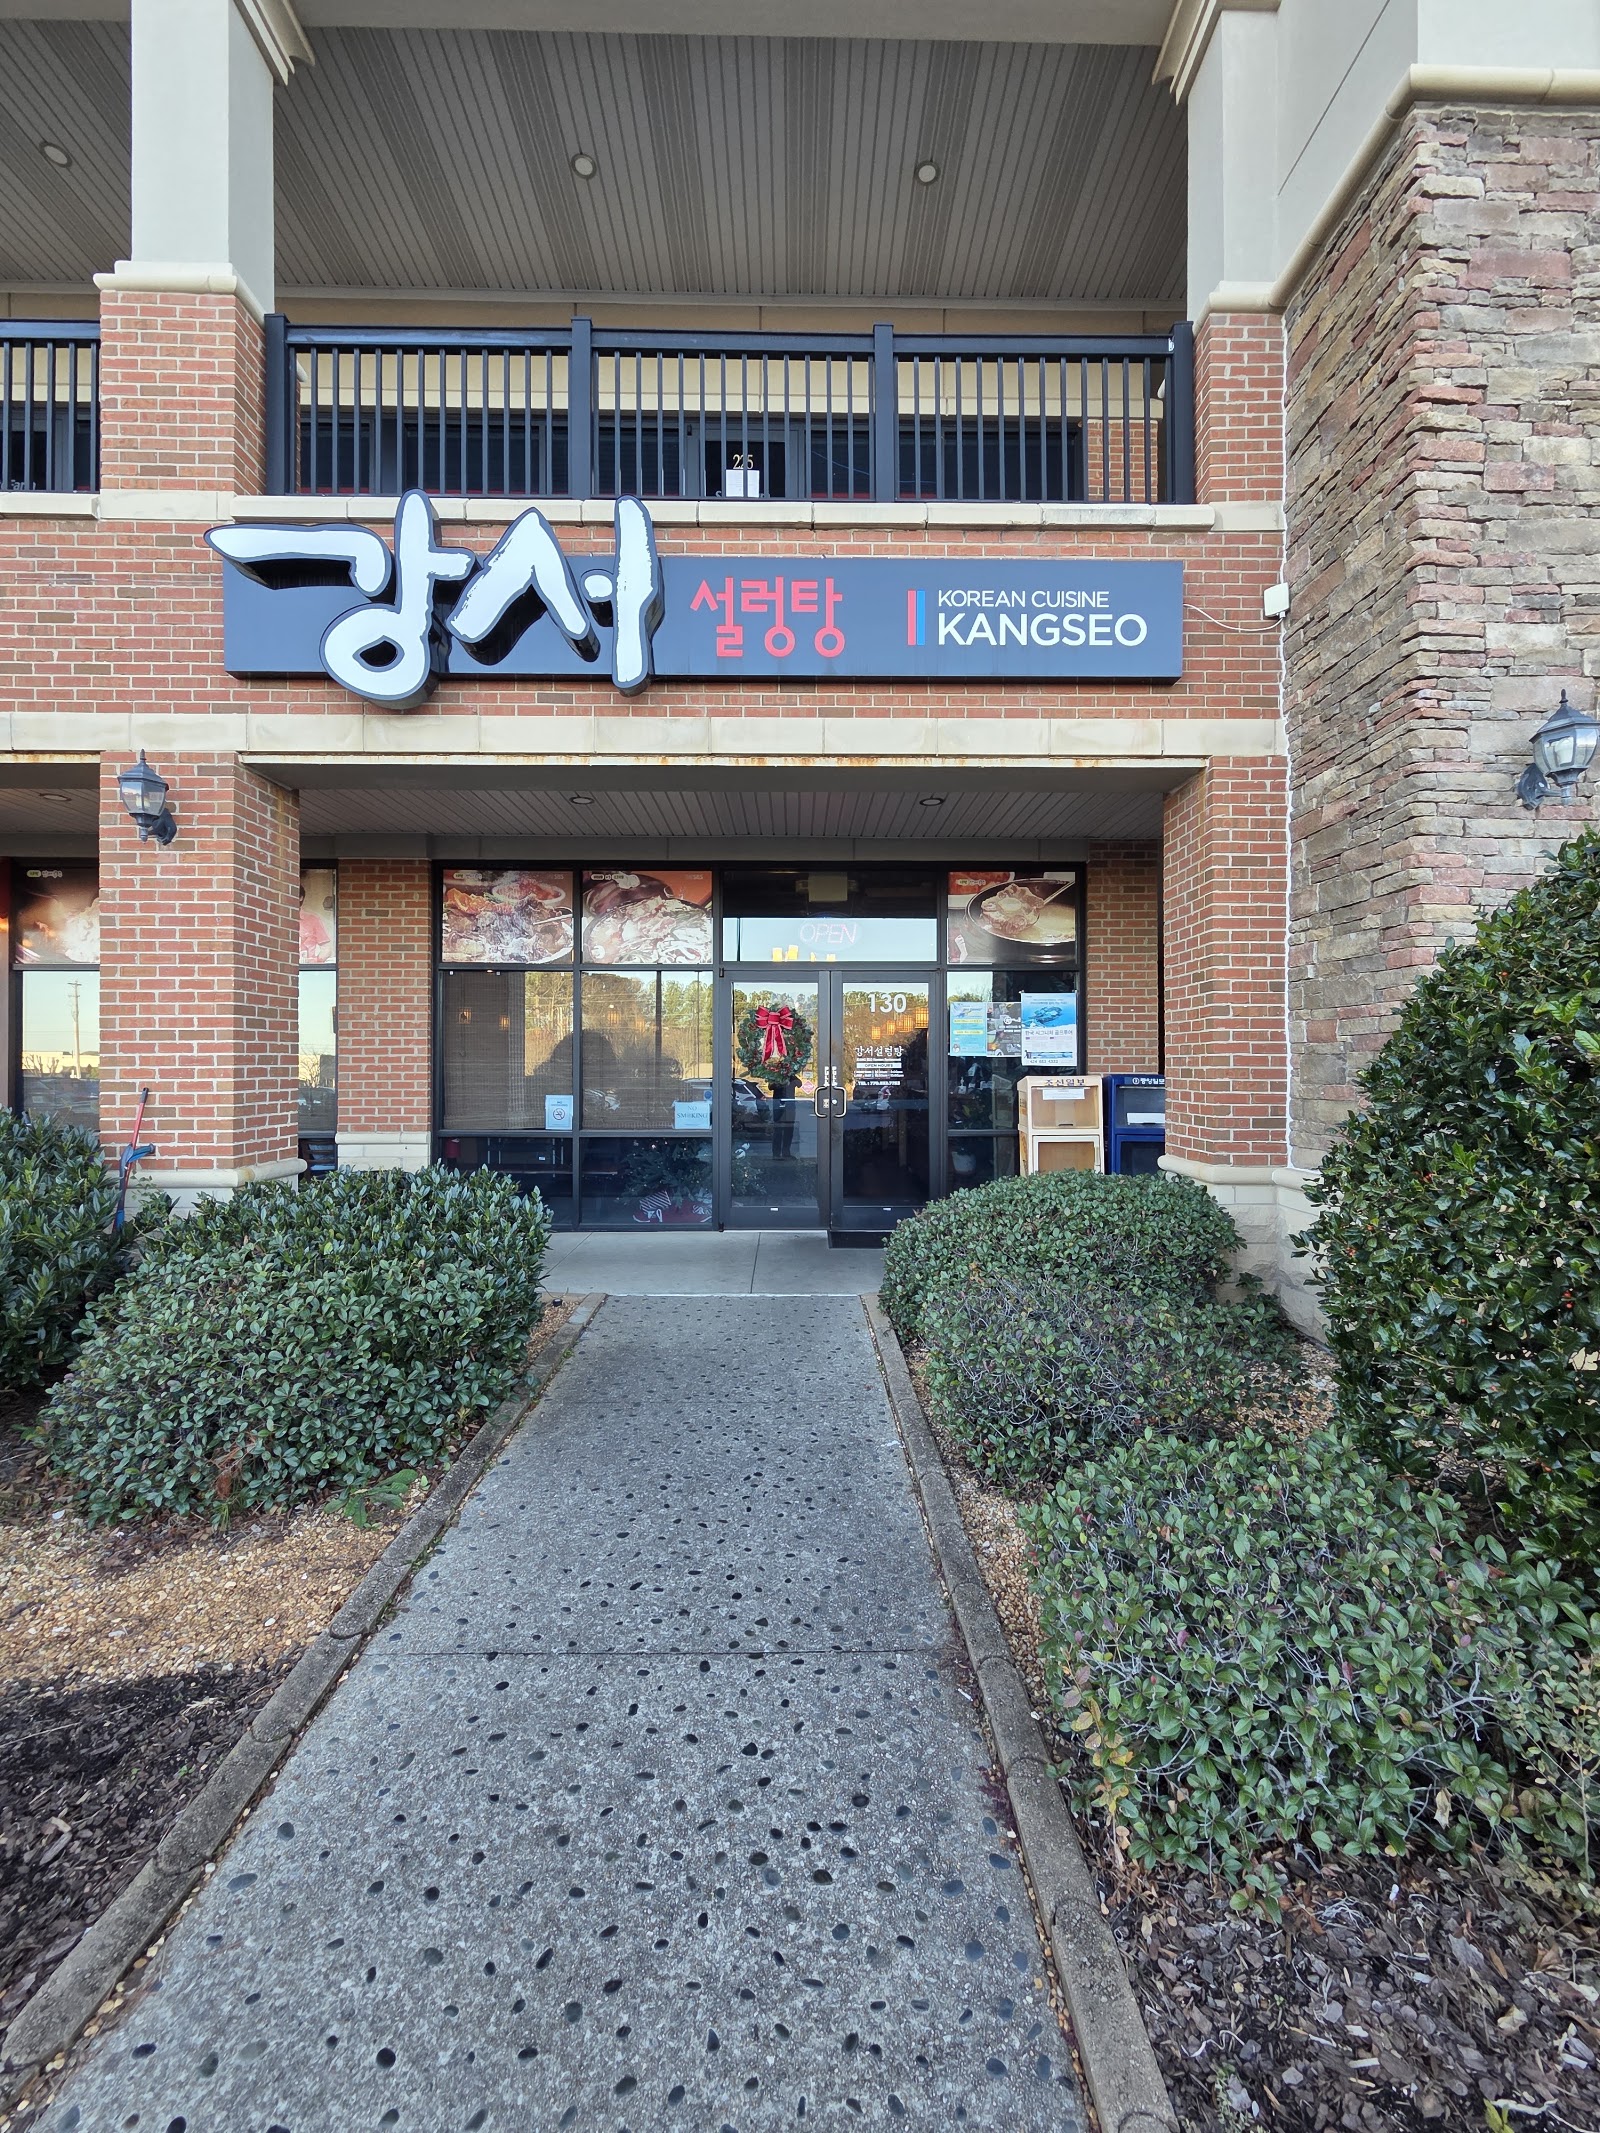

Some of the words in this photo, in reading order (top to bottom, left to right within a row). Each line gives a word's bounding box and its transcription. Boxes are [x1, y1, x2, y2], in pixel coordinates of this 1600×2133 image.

[938, 589, 1026, 608] KOREAN
[1031, 590, 1110, 608] CUISINE
[690, 576, 846, 658] 설렁탕
[938, 612, 1148, 647] KANGSEO
[800, 923, 857, 944] OPEN
[868, 993, 907, 1013] 130
